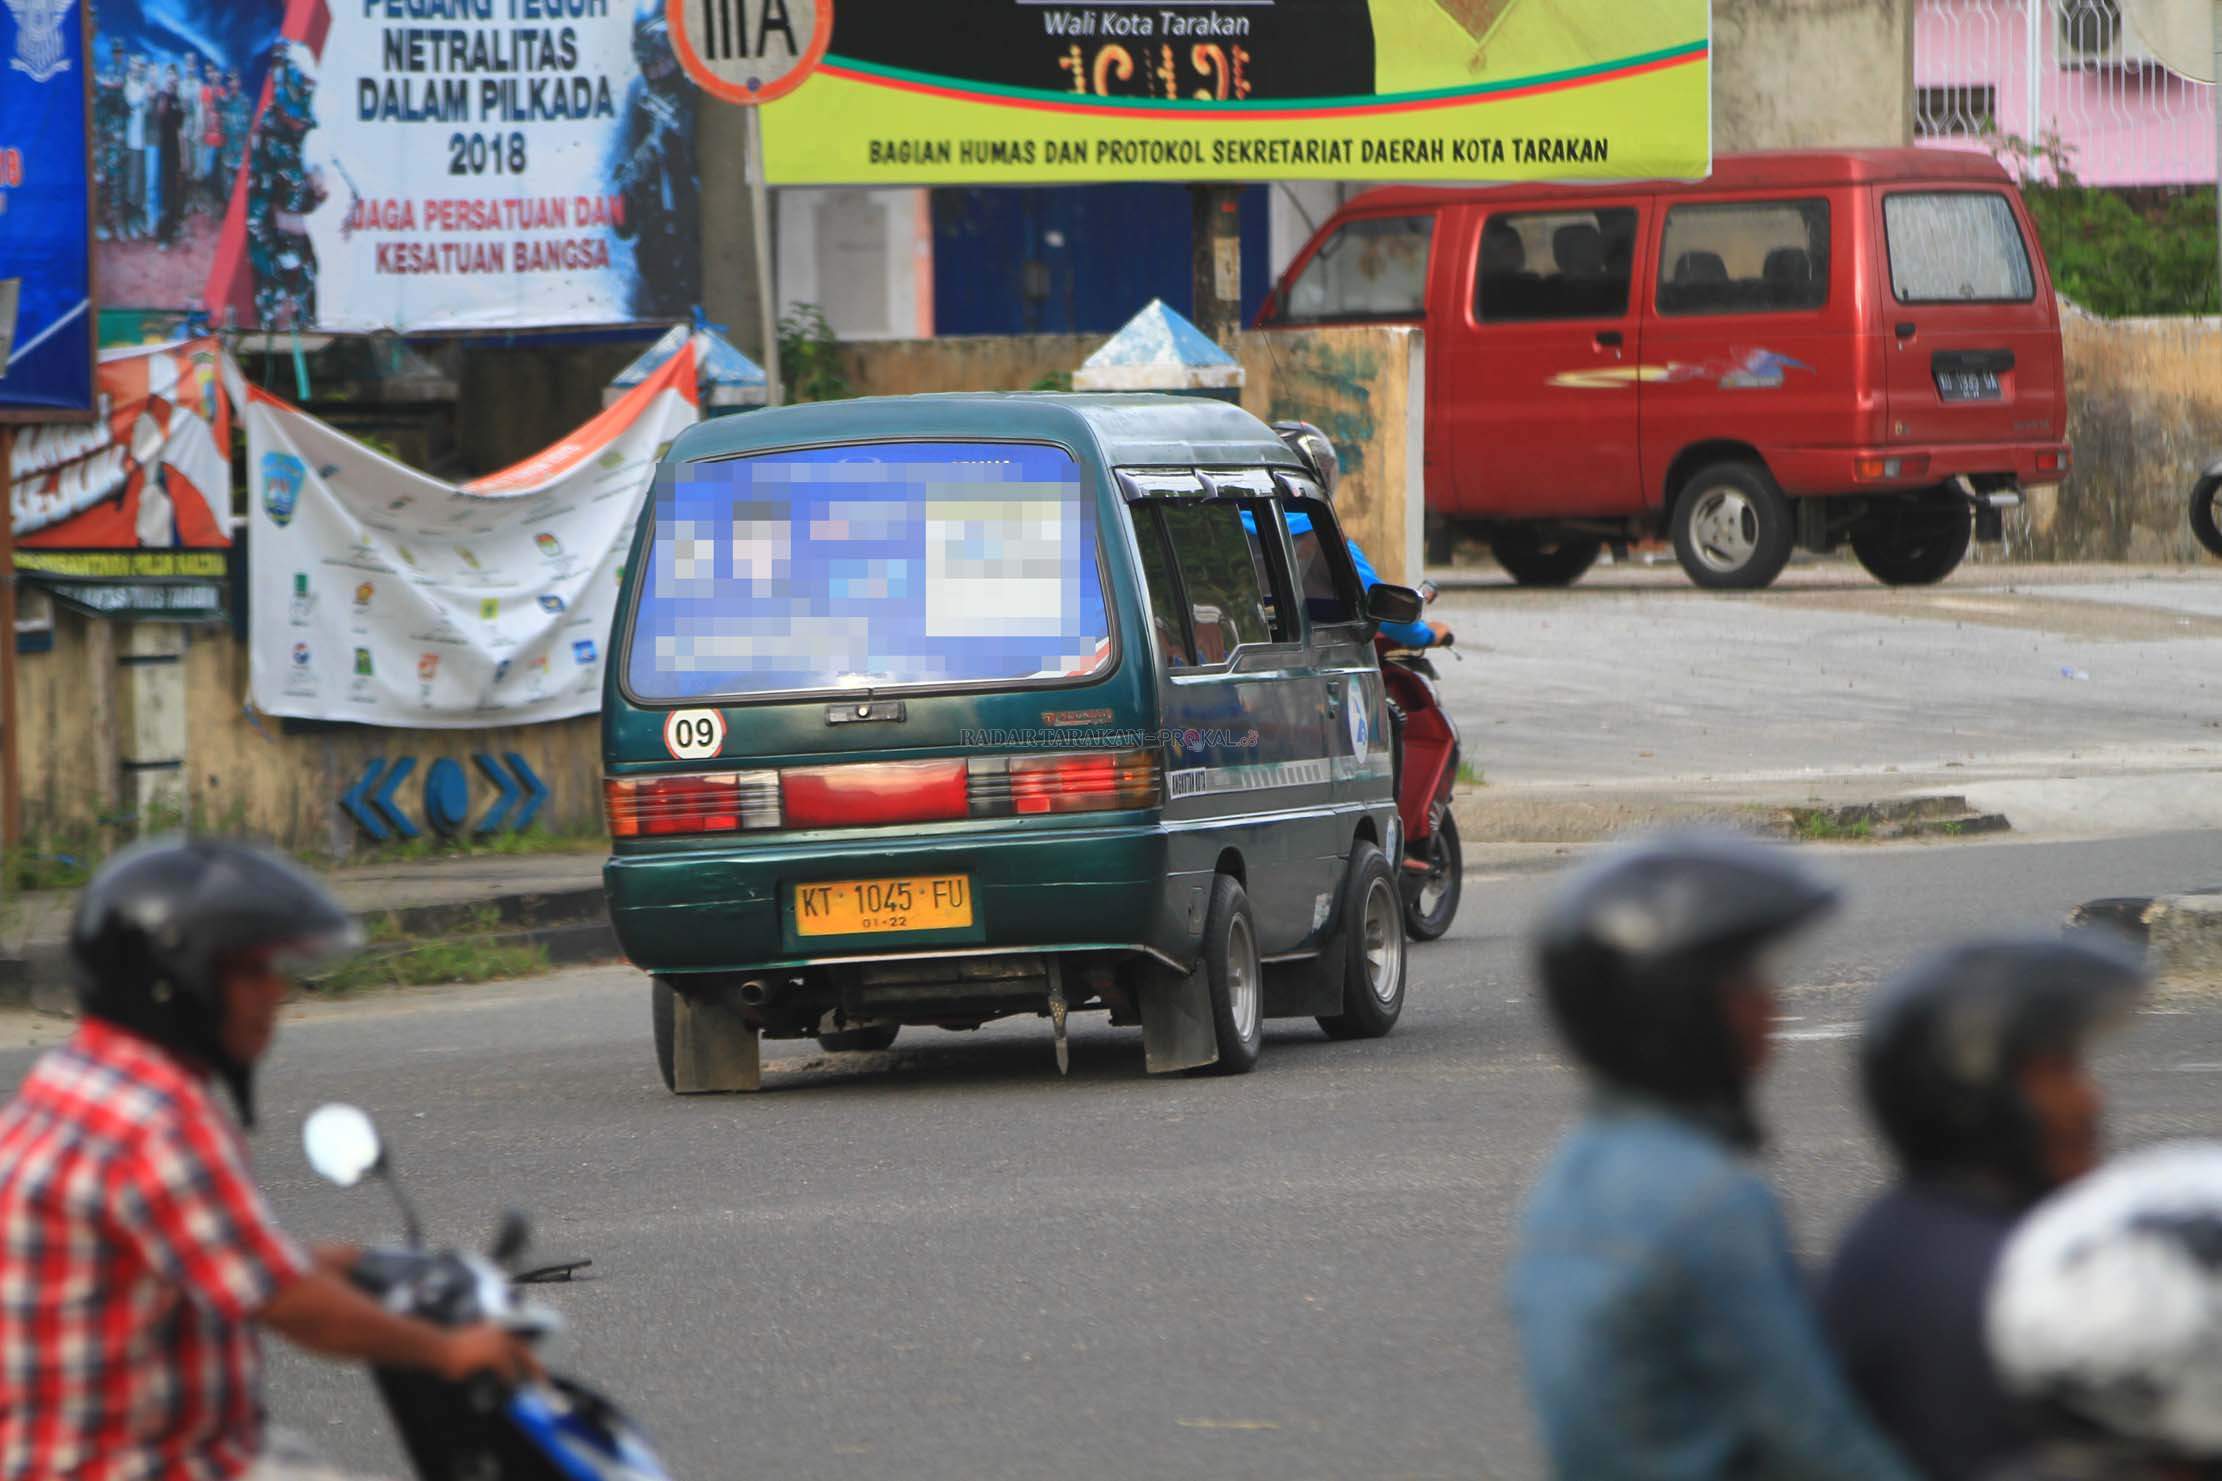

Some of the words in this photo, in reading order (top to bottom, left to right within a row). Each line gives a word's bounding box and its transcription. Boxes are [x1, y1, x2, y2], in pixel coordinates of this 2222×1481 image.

[1044, 11, 1097, 36] Wali
[1101, 11, 1153, 36] Kota
[1160, 11, 1250, 36] Tarakan
[383, 27, 577, 72] NETRALITAS
[358, 77, 468, 122] DALAM
[480, 75, 613, 121] PILKADA
[448, 131, 526, 175] 2018
[869, 140, 950, 164] BAGIAN
[959, 139, 1035, 164] HUMAS
[1045, 140, 1087, 164] DAN
[1096, 140, 1203, 164] PROTOKOL
[1213, 139, 1354, 164] SEKRETARIAT
[1362, 139, 1443, 163] DAERAH
[1453, 139, 1505, 163] KOTA
[1513, 138, 1609, 163] TARAKAN
[423, 197, 566, 231] PERSATUAN
[576, 194, 625, 226] DAN
[376, 242, 504, 274] KESATUAN
[513, 239, 609, 273] BANGSA
[675, 719, 714, 748] 09
[802, 888, 832, 916] KT
[854, 883, 912, 914] 1045
[932, 880, 963, 909] FU
